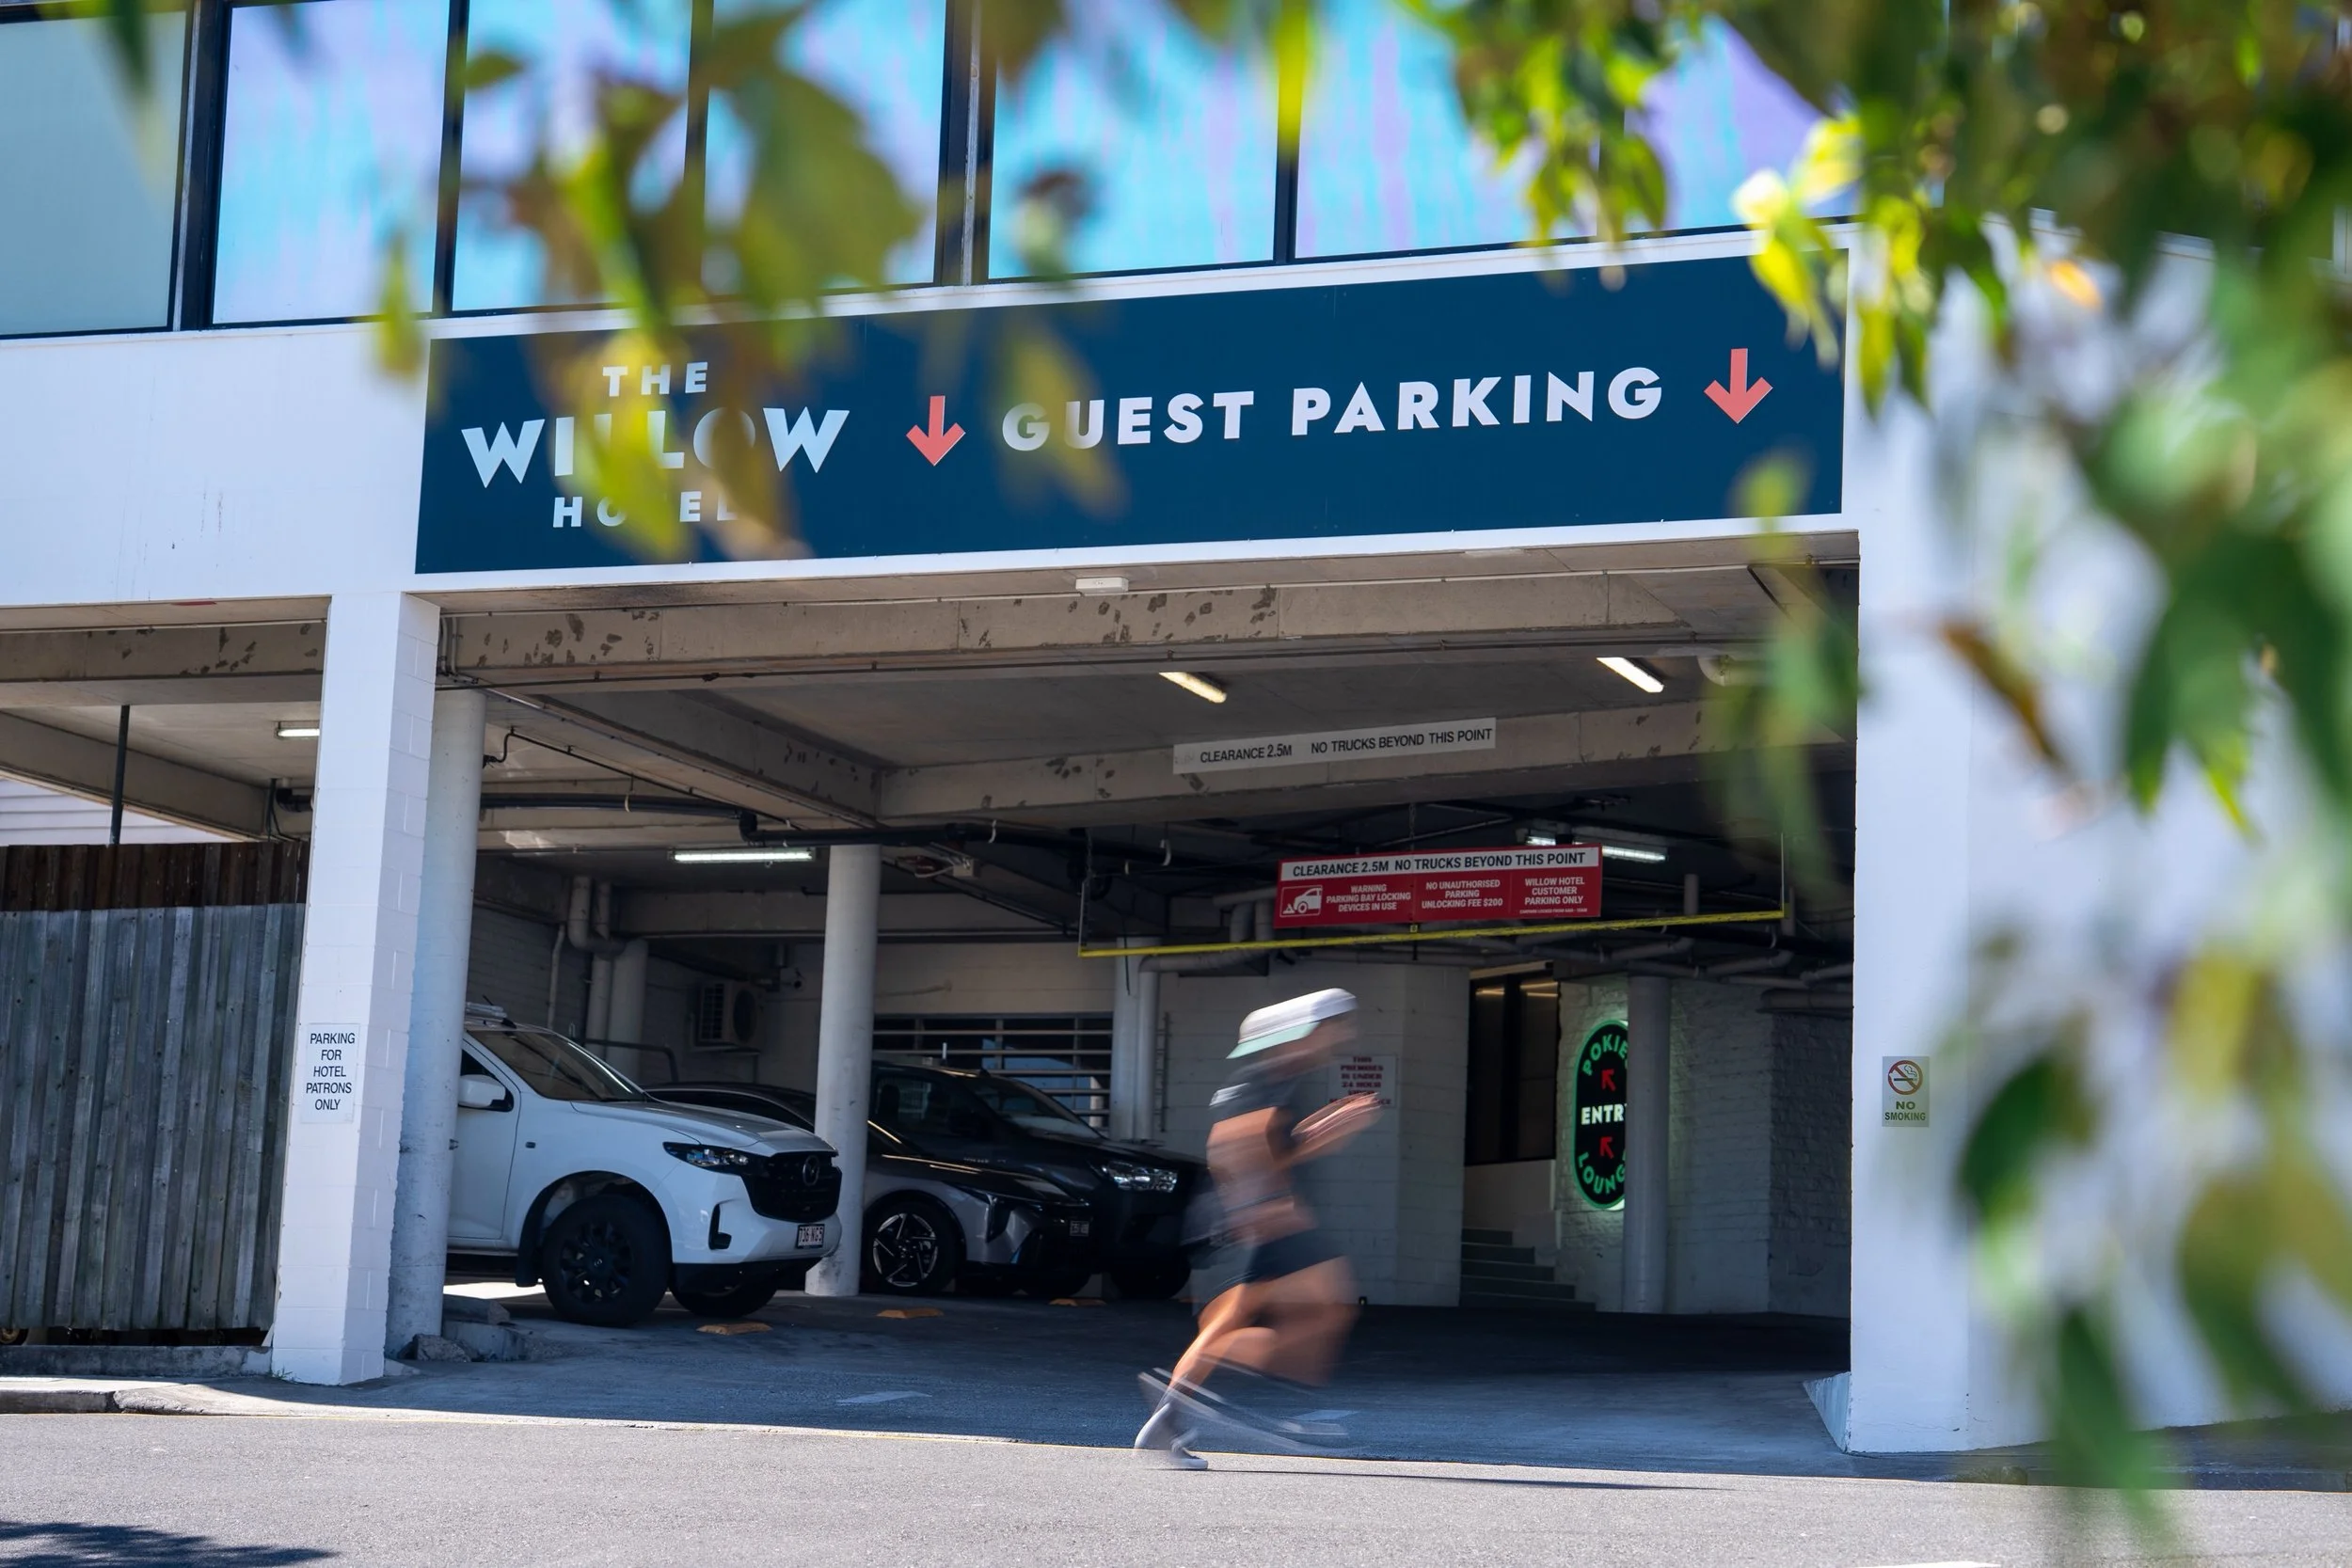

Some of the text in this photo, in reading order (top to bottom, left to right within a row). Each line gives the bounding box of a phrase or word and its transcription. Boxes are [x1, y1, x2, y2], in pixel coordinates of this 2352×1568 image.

[601, 361, 708, 397] THE
[1002, 366, 1662, 451] GUEST PARKING
[552, 491, 739, 529] HOEL
[1200, 728, 1492, 764] CLEARANCE 2.5M NO TRUCKS BEYOND THIS POINT
[1293, 852, 1585, 877] CLEARANCE 2.5M NO TRUCKS BEYOND THIS POINT
[1425, 879, 1501, 891] NO UNAUTHORISED
[1525, 877, 1585, 887] WILLOW HOTEL
[1350, 883, 1388, 894] WARNING
[1445, 889, 1480, 899] PARKING
[1532, 886, 1578, 895] CUSTOMER
[1326, 892, 1411, 904] PARKING BAY LOCKING
[1422, 897, 1503, 909] UNLOCKING FEE $200
[1524, 895, 1584, 906] PARKING ONLY
[1338, 901, 1397, 912] DEVICES IN USE
[310, 1032, 356, 1044] PARKING
[321, 1050, 342, 1061] FOR
[1581, 1034, 1629, 1076] POKIE
[313, 1066, 346, 1077] HOTEL
[306, 1082, 352, 1094] PATRONS
[314, 1099, 341, 1111] ONLY
[1896, 1101, 1915, 1110] NO
[1581, 1103, 1628, 1125] ENTR
[1884, 1112, 1926, 1120] SMOKING
[1578, 1148, 1626, 1195] LOUNG
